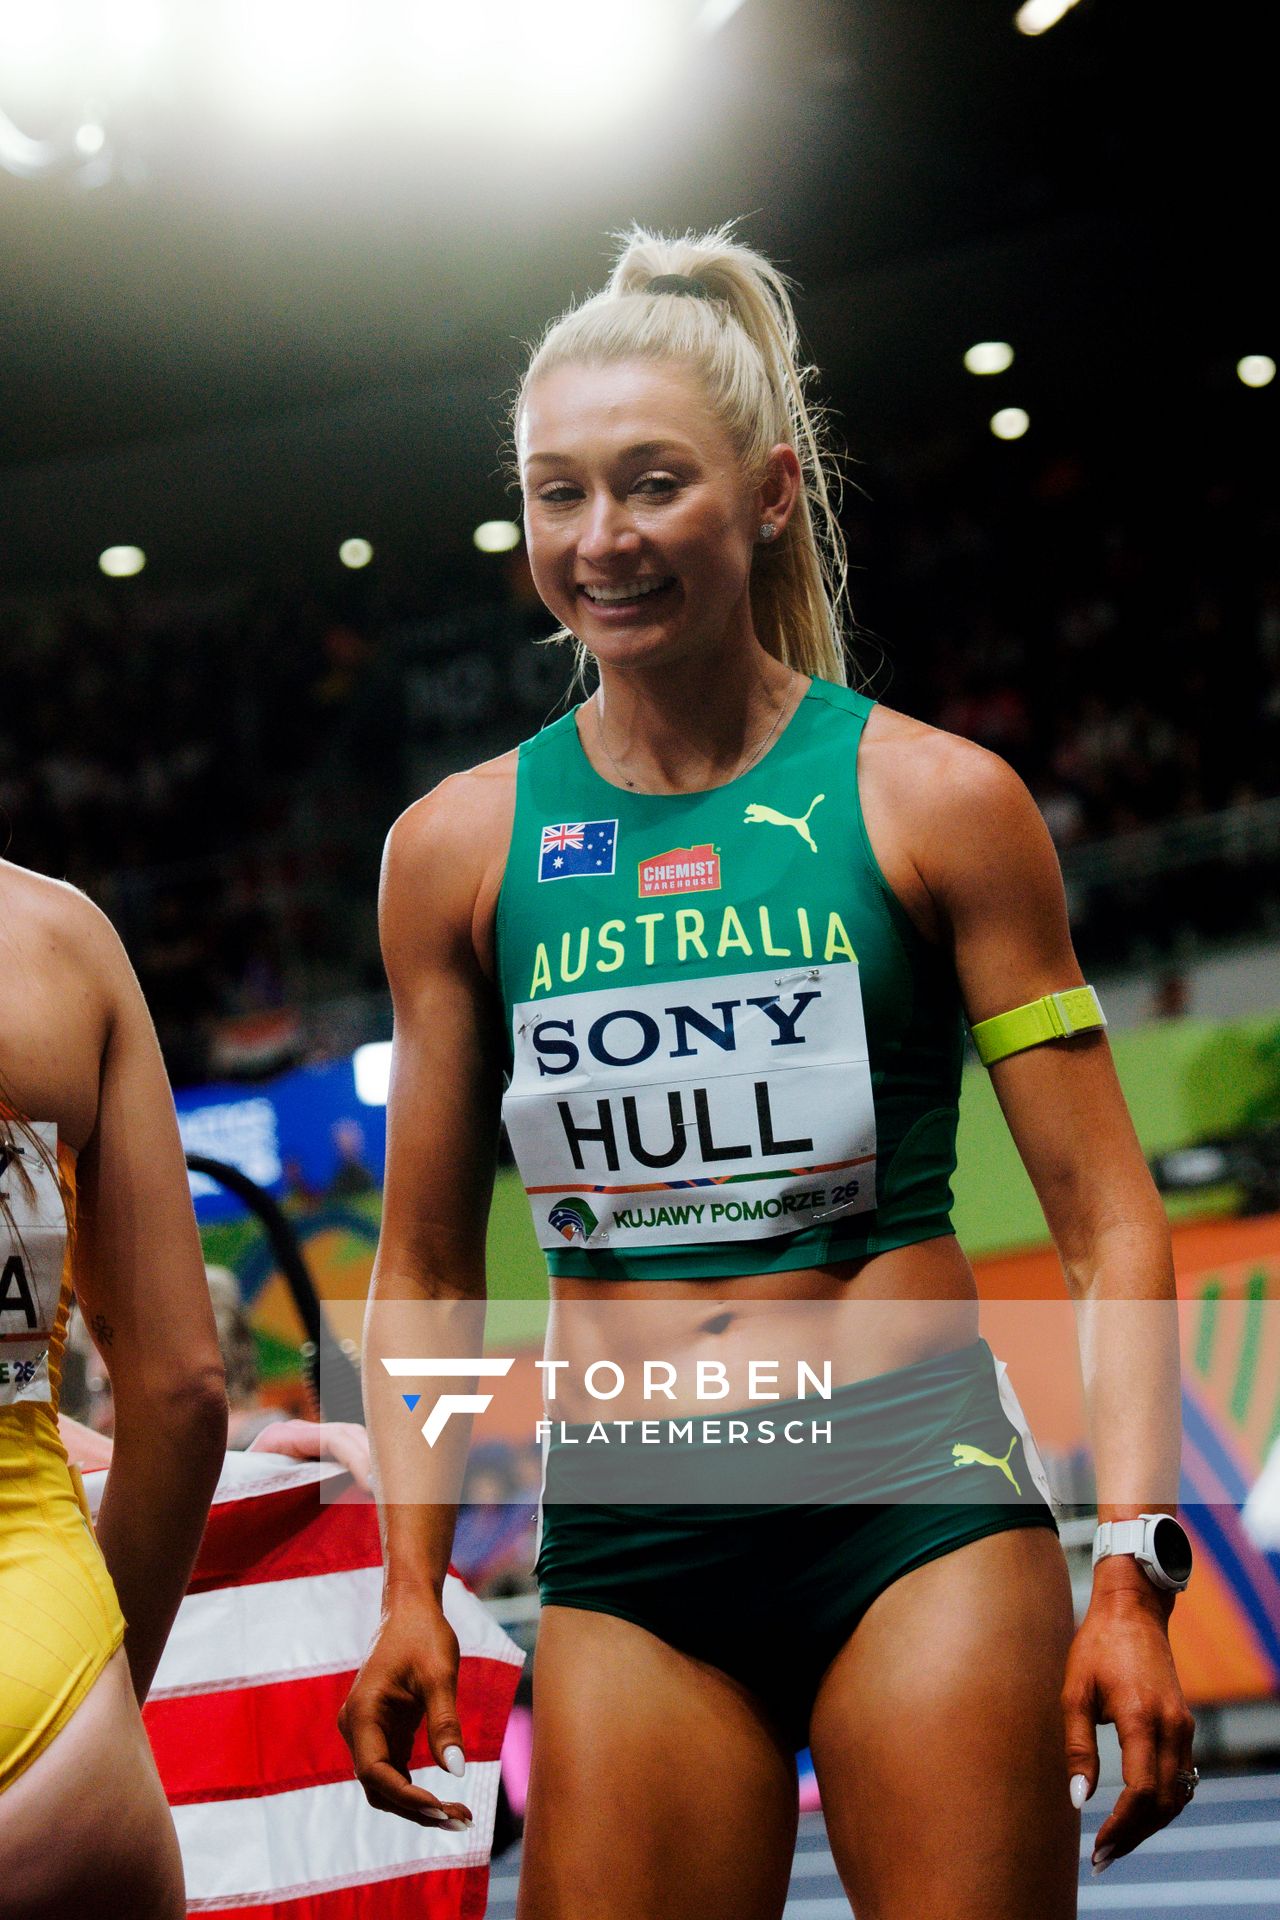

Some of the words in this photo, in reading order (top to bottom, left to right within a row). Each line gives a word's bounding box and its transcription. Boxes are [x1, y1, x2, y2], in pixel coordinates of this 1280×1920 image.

[643, 860, 715, 882] CHEMIST
[644, 877, 714, 891] WAREHOUSE
[529, 905, 859, 999] AUSTRALIA
[532, 990, 822, 1077] SONY
[556, 1081, 814, 1172] HULL
[612, 1205, 705, 1229] KUJAWY
[710, 1189, 826, 1223] POMORZE
[831, 1180, 860, 1205] 26
